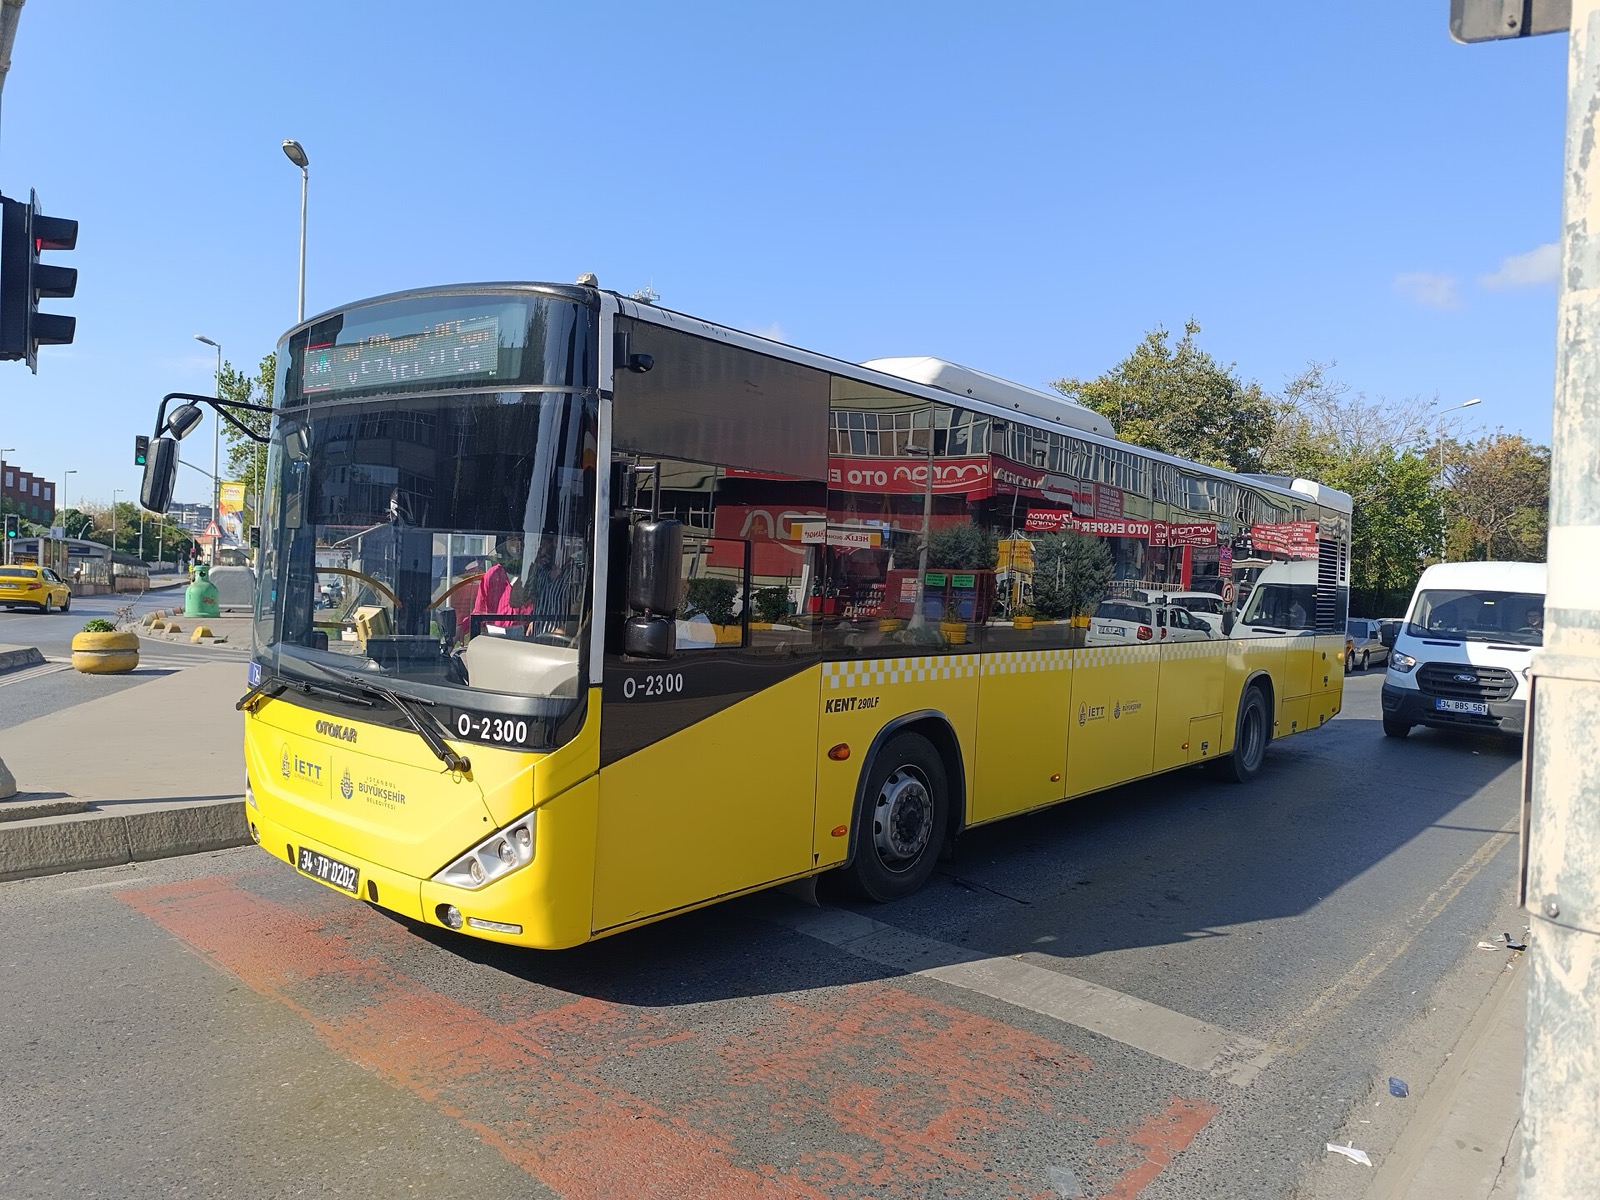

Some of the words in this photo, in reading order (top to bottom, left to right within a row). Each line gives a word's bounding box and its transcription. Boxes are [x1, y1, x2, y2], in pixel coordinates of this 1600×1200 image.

[623, 673, 684, 698] O-2300
[825, 697, 858, 713] KENT
[858, 696, 880, 709] 290LF
[1441, 700, 1450, 708] 34
[1454, 702, 1469, 710] BBS
[1472, 704, 1486, 712] 561
[315, 719, 358, 743] OTOKAR
[457, 714, 528, 743] O-2300
[301, 850, 313, 871] 34
[317, 856, 329, 878] TR
[330, 862, 356, 890] 0202
